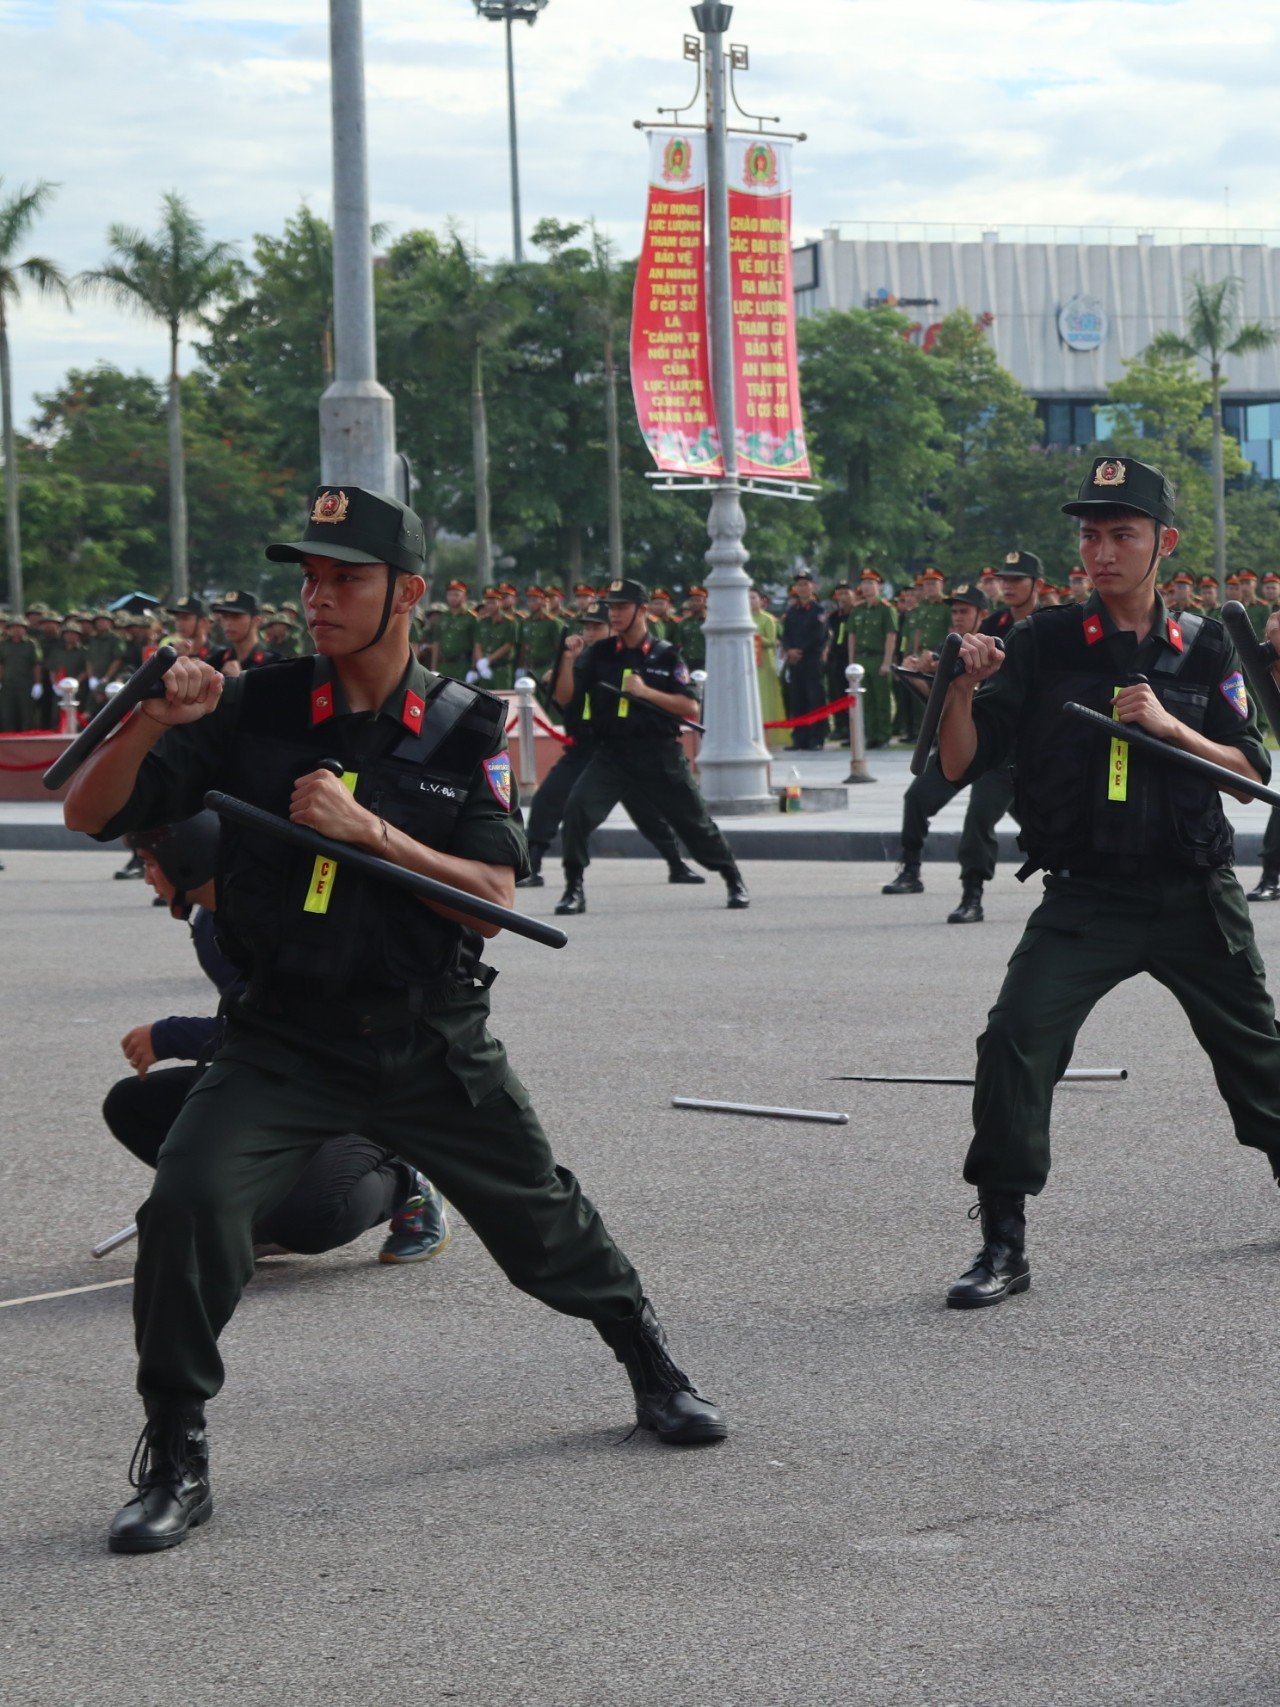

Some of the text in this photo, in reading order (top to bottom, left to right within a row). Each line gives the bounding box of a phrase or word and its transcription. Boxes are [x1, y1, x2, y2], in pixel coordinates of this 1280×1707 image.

[650, 201, 699, 217] XÂY DỰNG
[648, 219, 701, 233] LỰC LƯỢNG
[730, 214, 758, 231] CHÀO
[650, 235, 699, 248] THAM GIA
[728, 235, 748, 251] CÁC
[751, 239, 767, 256] ĐẠI
[654, 248, 693, 266] BẢO VỆ
[738, 256, 752, 273] VỀ
[771, 256, 785, 274] LỄ
[648, 268, 698, 279] AN NINH
[650, 282, 698, 298] TRẬT TỰ
[741, 277, 783, 295] RA MẮT
[660, 299, 677, 311] CƠ
[680, 297, 698, 311] SỞ
[733, 299, 753, 316] LỰC
[664, 315, 682, 328] LÀ
[737, 320, 768, 335] THAM
[647, 345, 670, 359] NỐI
[745, 338, 784, 359] BẢO VỆ
[662, 361, 690, 375] CỦA
[742, 363, 758, 376] AN
[643, 380, 666, 394] LỰC
[746, 380, 773, 399] TRẬT
[651, 395, 686, 407] CÔNG
[648, 410, 681, 422] NHÂN
